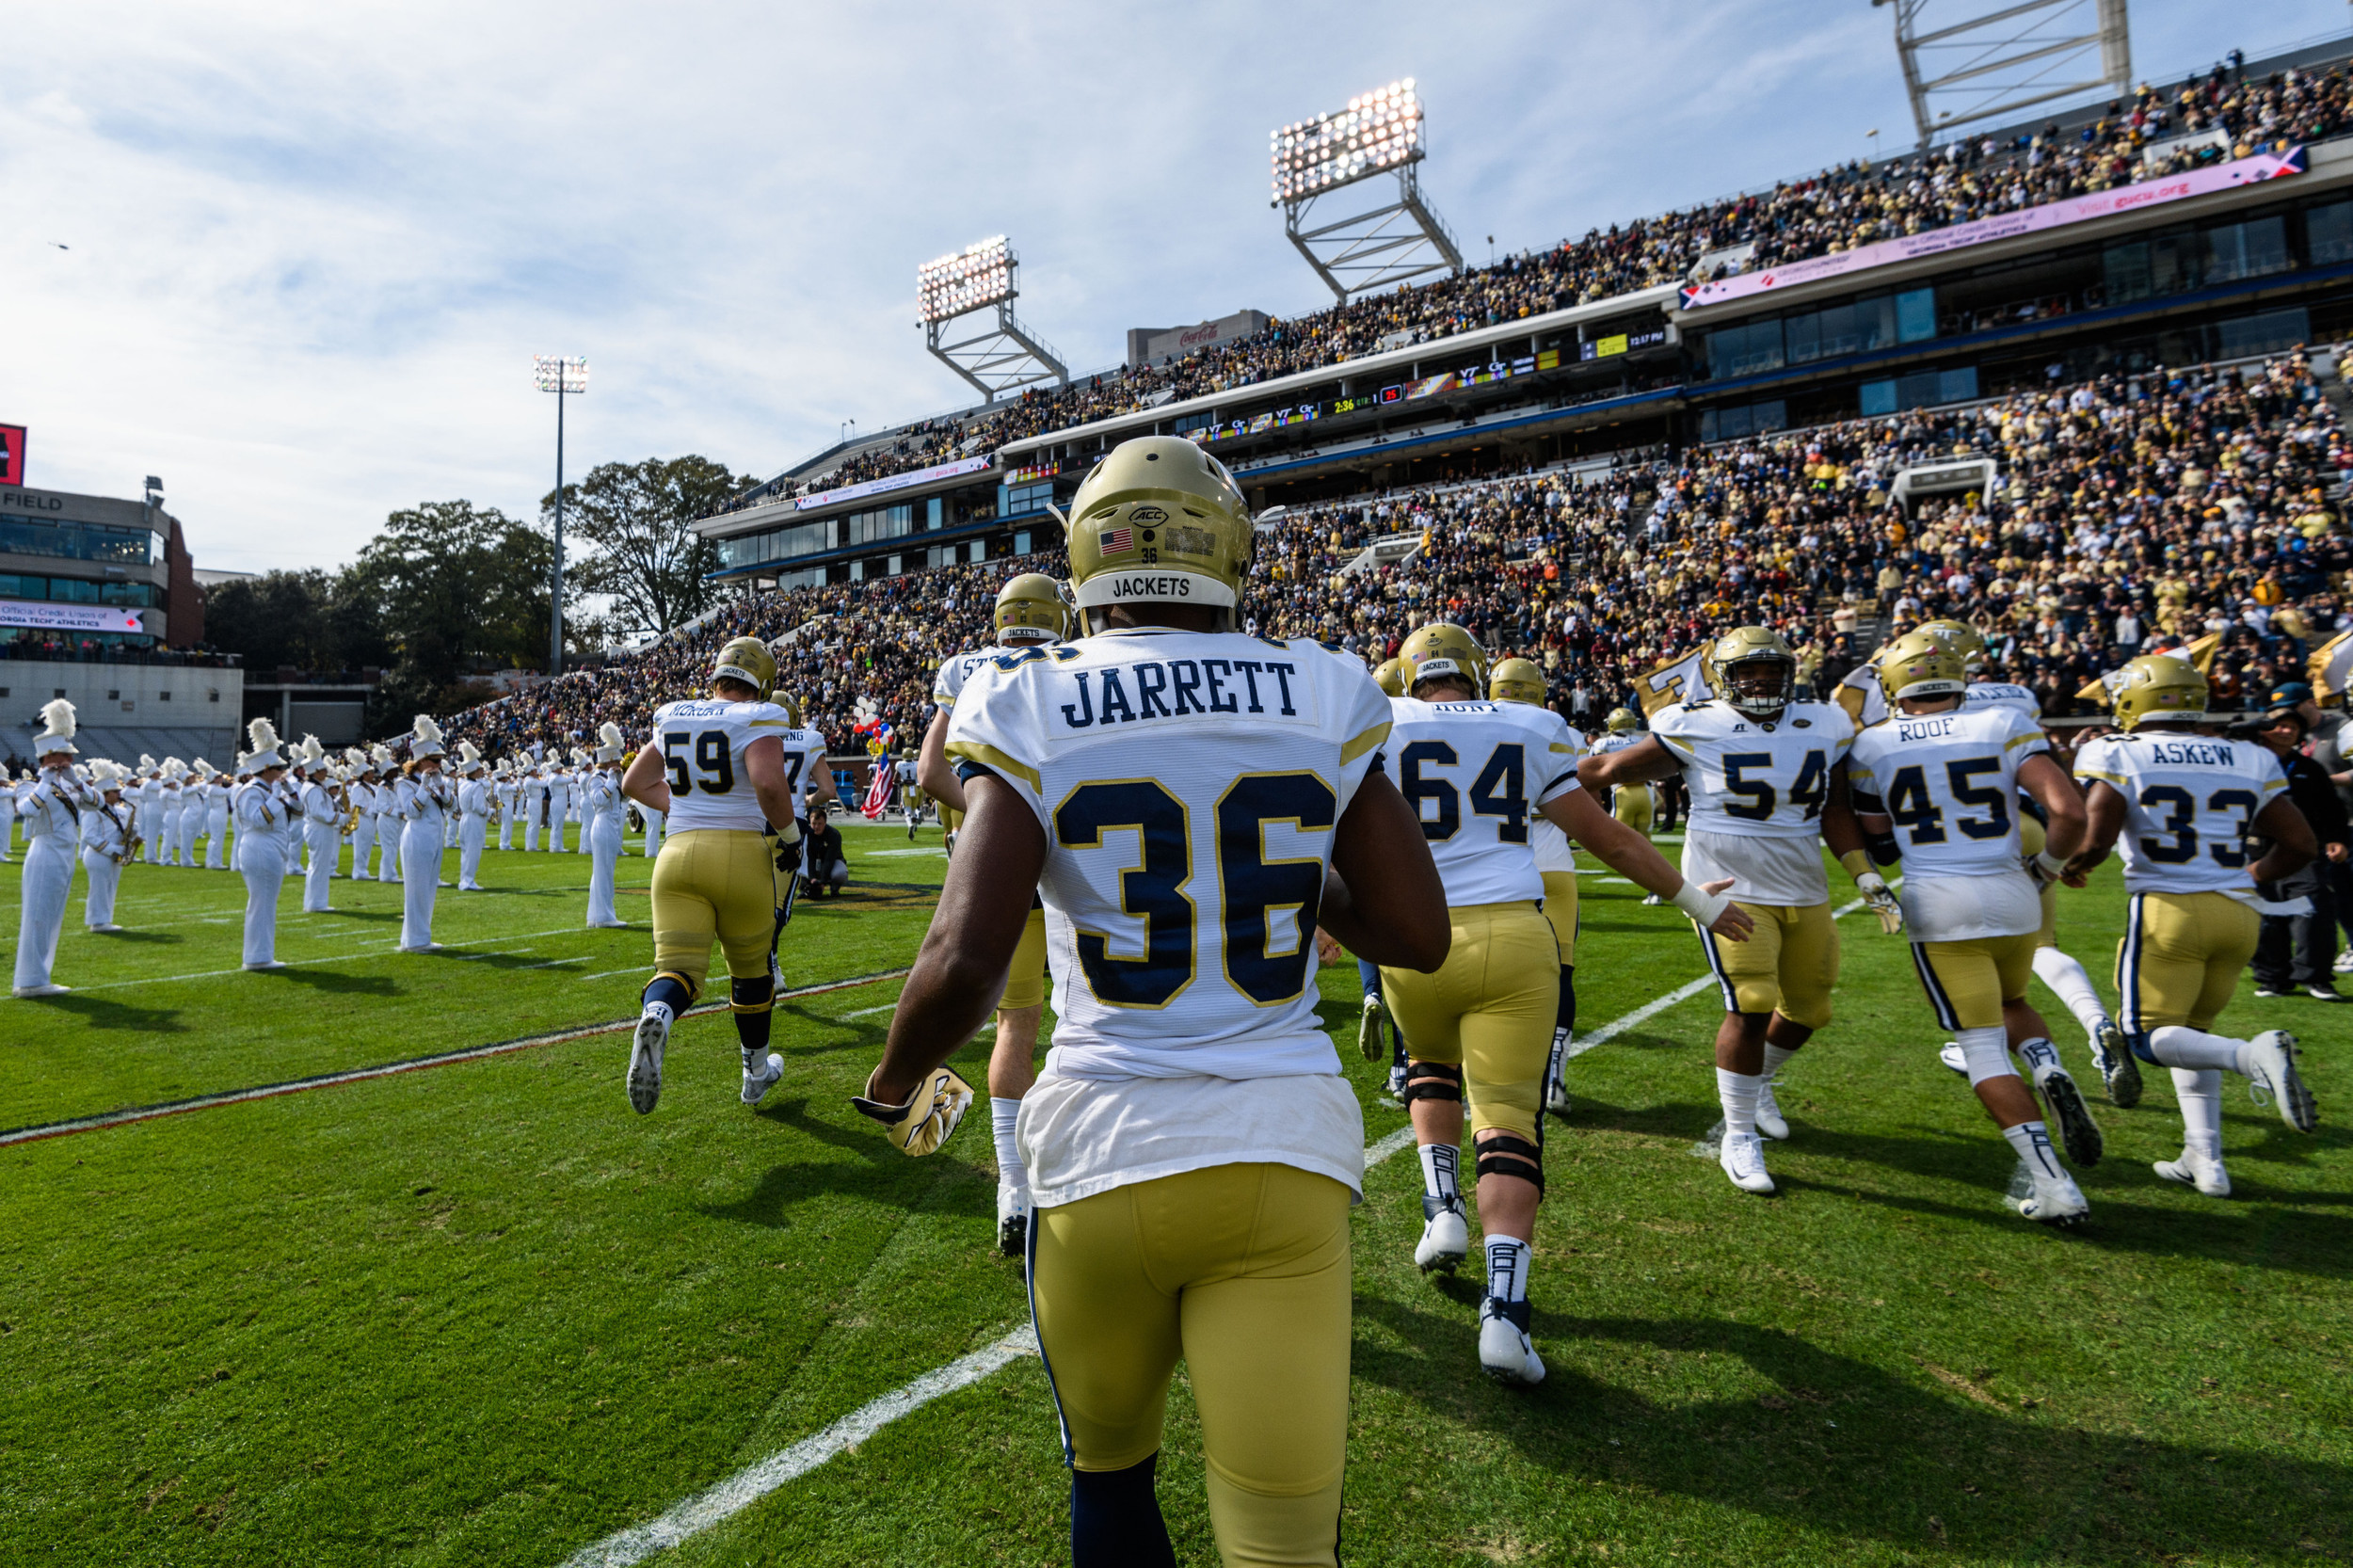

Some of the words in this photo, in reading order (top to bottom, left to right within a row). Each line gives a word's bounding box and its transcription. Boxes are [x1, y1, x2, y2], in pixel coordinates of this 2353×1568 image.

[2113, 183, 2190, 209] gucu.org
[1460, 366, 1480, 378] VT
[1385, 390, 1397, 400] 25
[1275, 408, 1293, 418] VT
[1335, 399, 1354, 414] 2:36
[1209, 423, 1224, 433] VT
[4, 493, 62, 510] FIELD
[1135, 511, 1162, 520] ACC
[1141, 547, 1158, 564] 36
[1113, 577, 1190, 598] JACKETS
[1008, 629, 1040, 637] JACKETS
[723, 667, 746, 678] JACKETS
[1422, 661, 1450, 671] JACKETS
[1061, 659, 1296, 728] JARRETT
[1899, 717, 1955, 743] ROOF
[664, 729, 735, 796] 59
[2153, 744, 2235, 766] ASKEW
[1399, 739, 1529, 845] 64
[1721, 749, 1827, 822] 54
[1888, 756, 2011, 845] 45
[2138, 784, 2259, 870] 33
[1051, 768, 1338, 1011] 36
